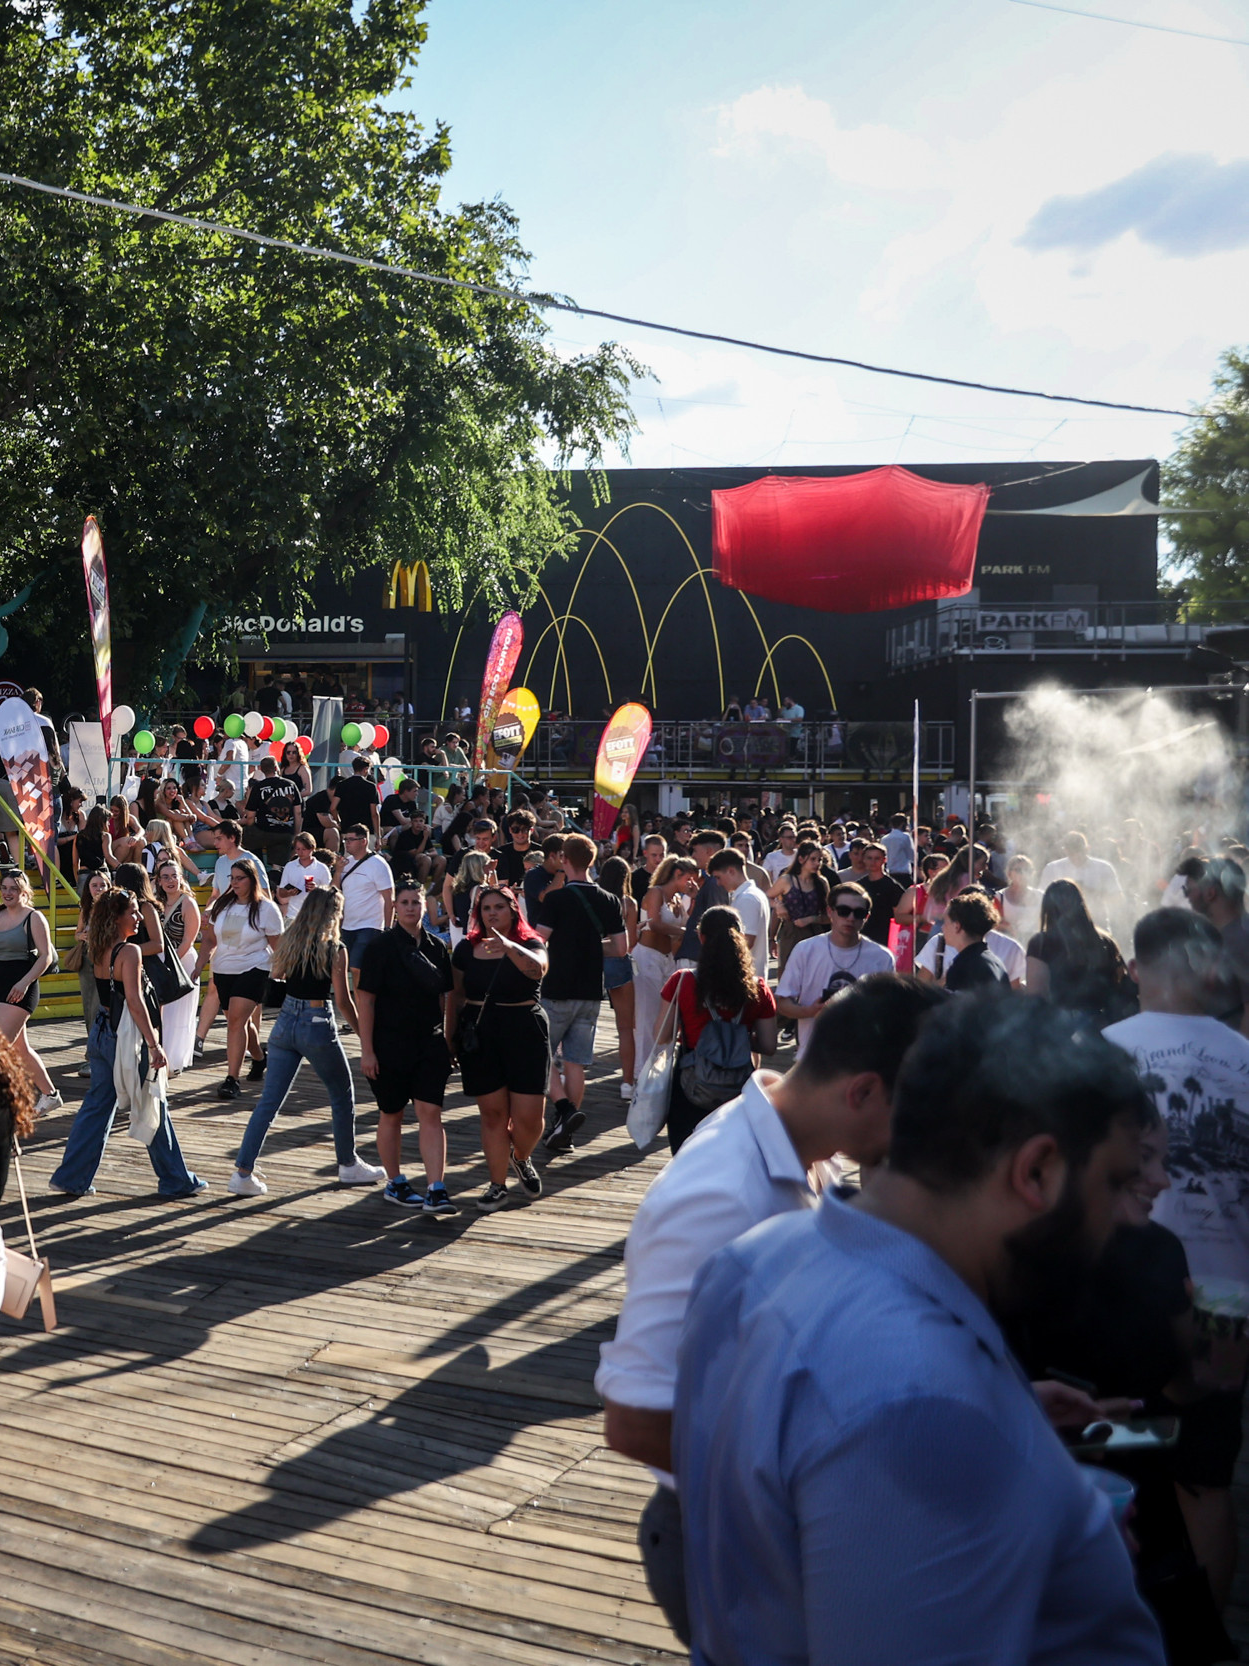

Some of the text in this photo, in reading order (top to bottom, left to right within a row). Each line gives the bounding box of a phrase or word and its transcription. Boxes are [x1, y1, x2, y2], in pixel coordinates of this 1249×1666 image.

[980, 564, 1051, 575] PARK FM
[493, 725, 521, 740] EFOTT
[605, 737, 635, 752] EFOTT
